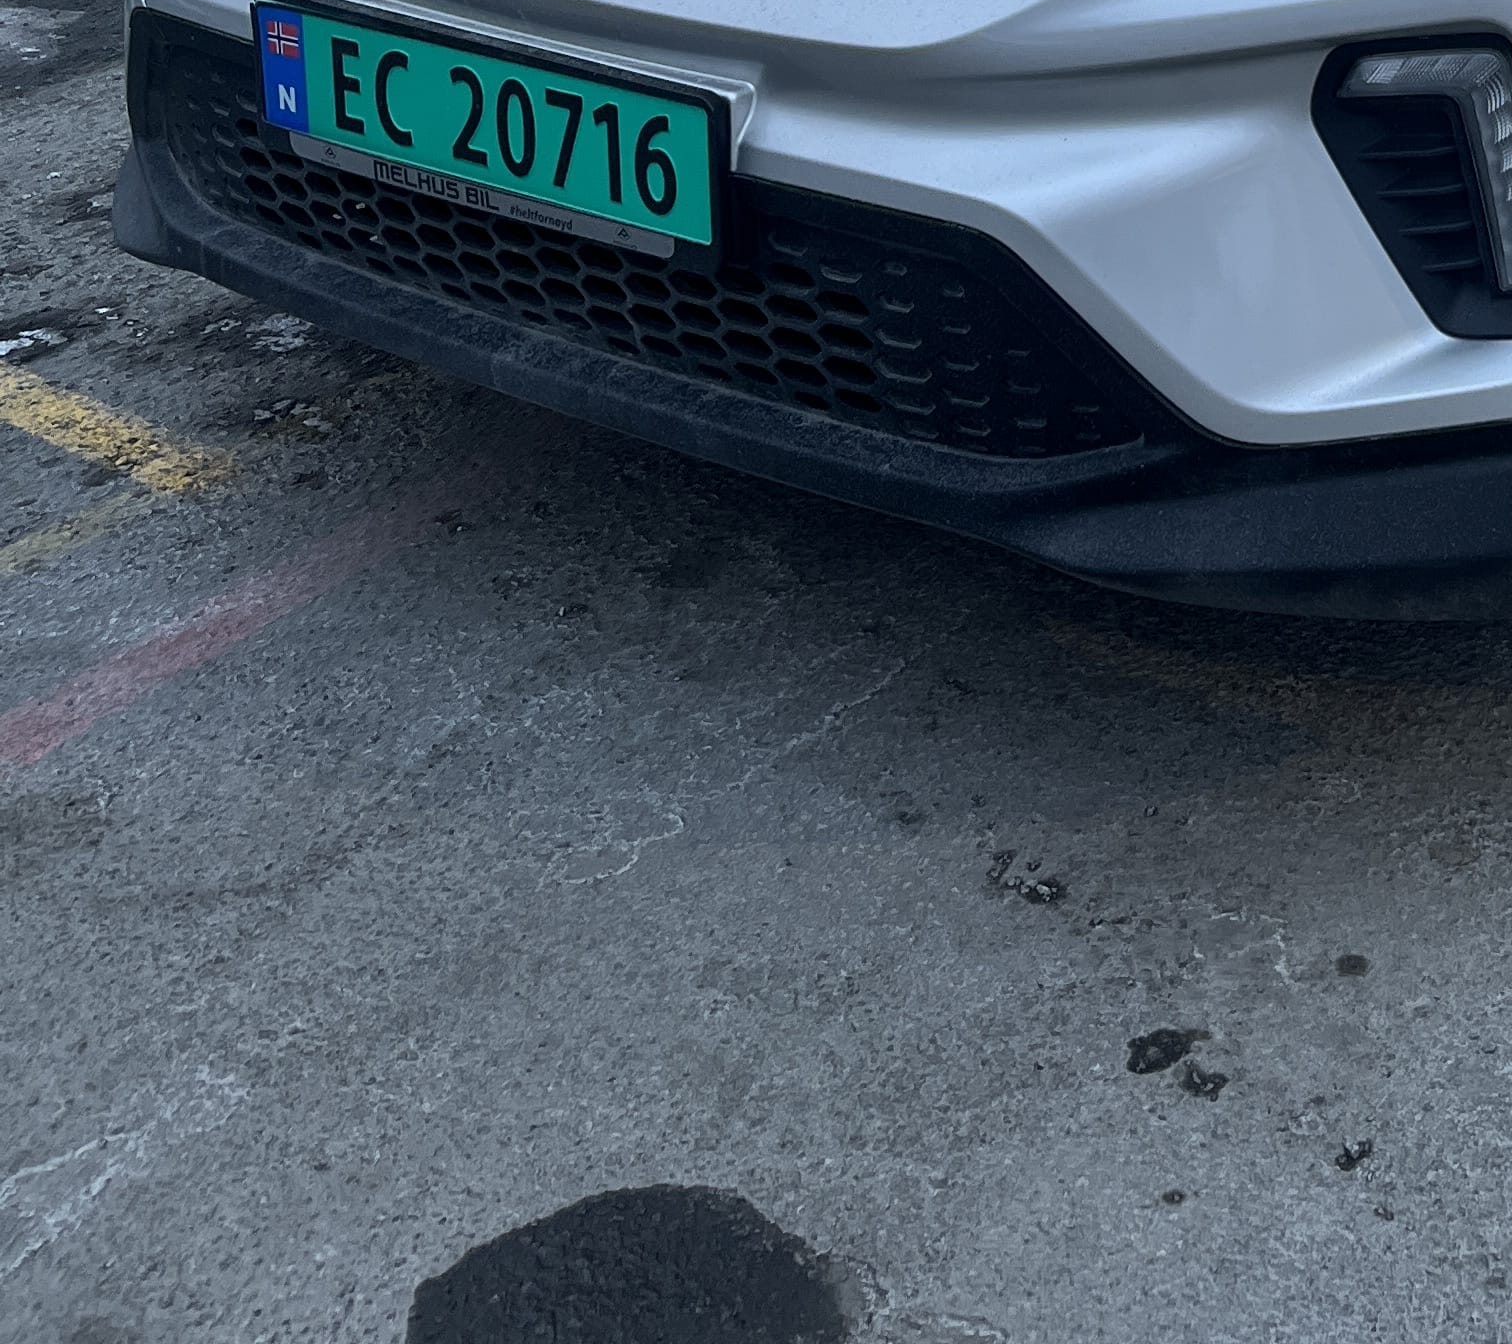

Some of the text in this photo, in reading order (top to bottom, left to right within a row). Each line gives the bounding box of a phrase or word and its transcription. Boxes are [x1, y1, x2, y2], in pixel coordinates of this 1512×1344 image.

[277, 84, 297, 114] N
[331, 36, 678, 217] EC 20716
[373, 160, 460, 200] MELHUS
[465, 185, 500, 211] BIL
